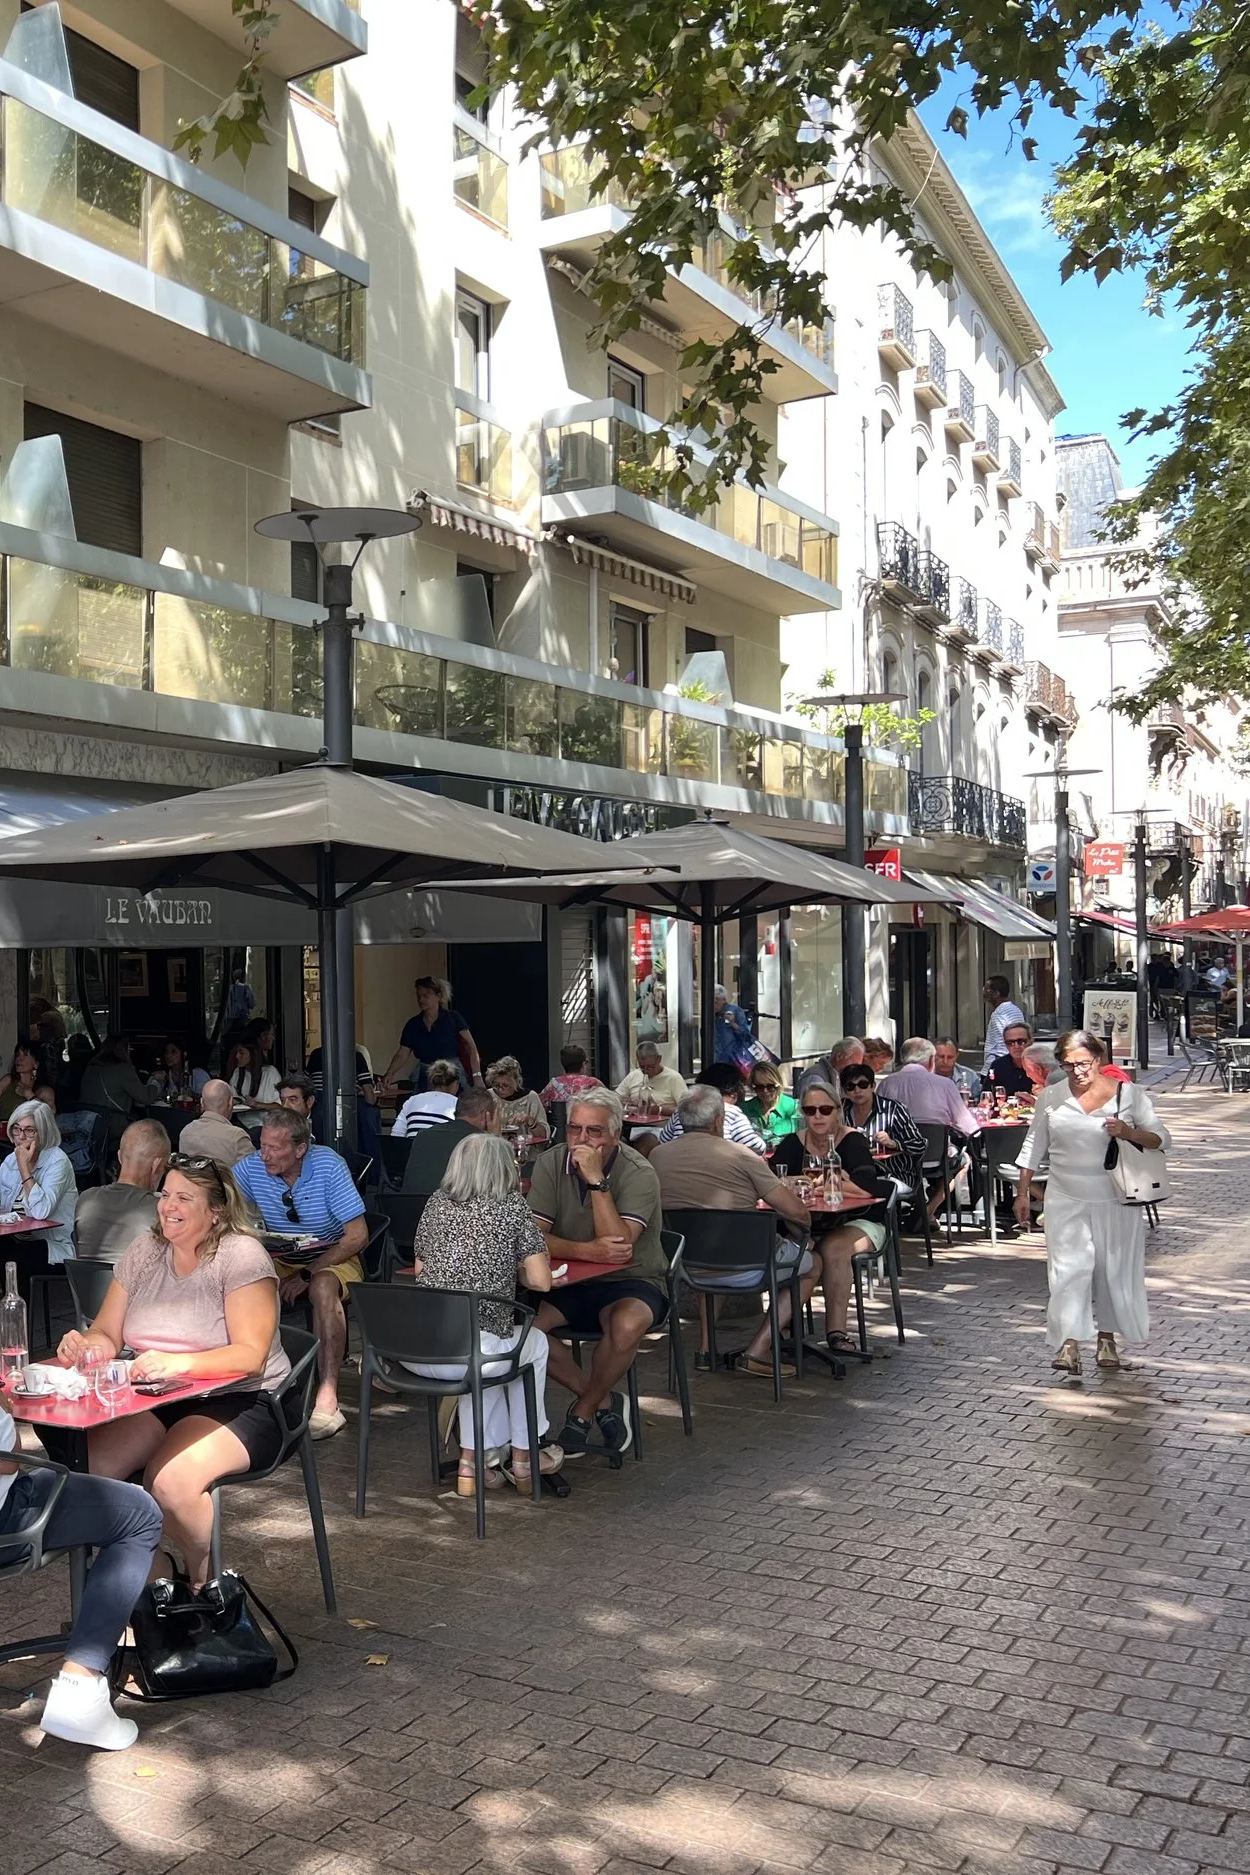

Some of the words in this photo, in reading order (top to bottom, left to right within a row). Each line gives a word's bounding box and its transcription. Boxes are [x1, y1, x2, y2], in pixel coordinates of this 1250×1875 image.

[864, 862, 897, 877] SFR
[105, 898, 129, 923] LE
[135, 898, 212, 924] VAUBAN
